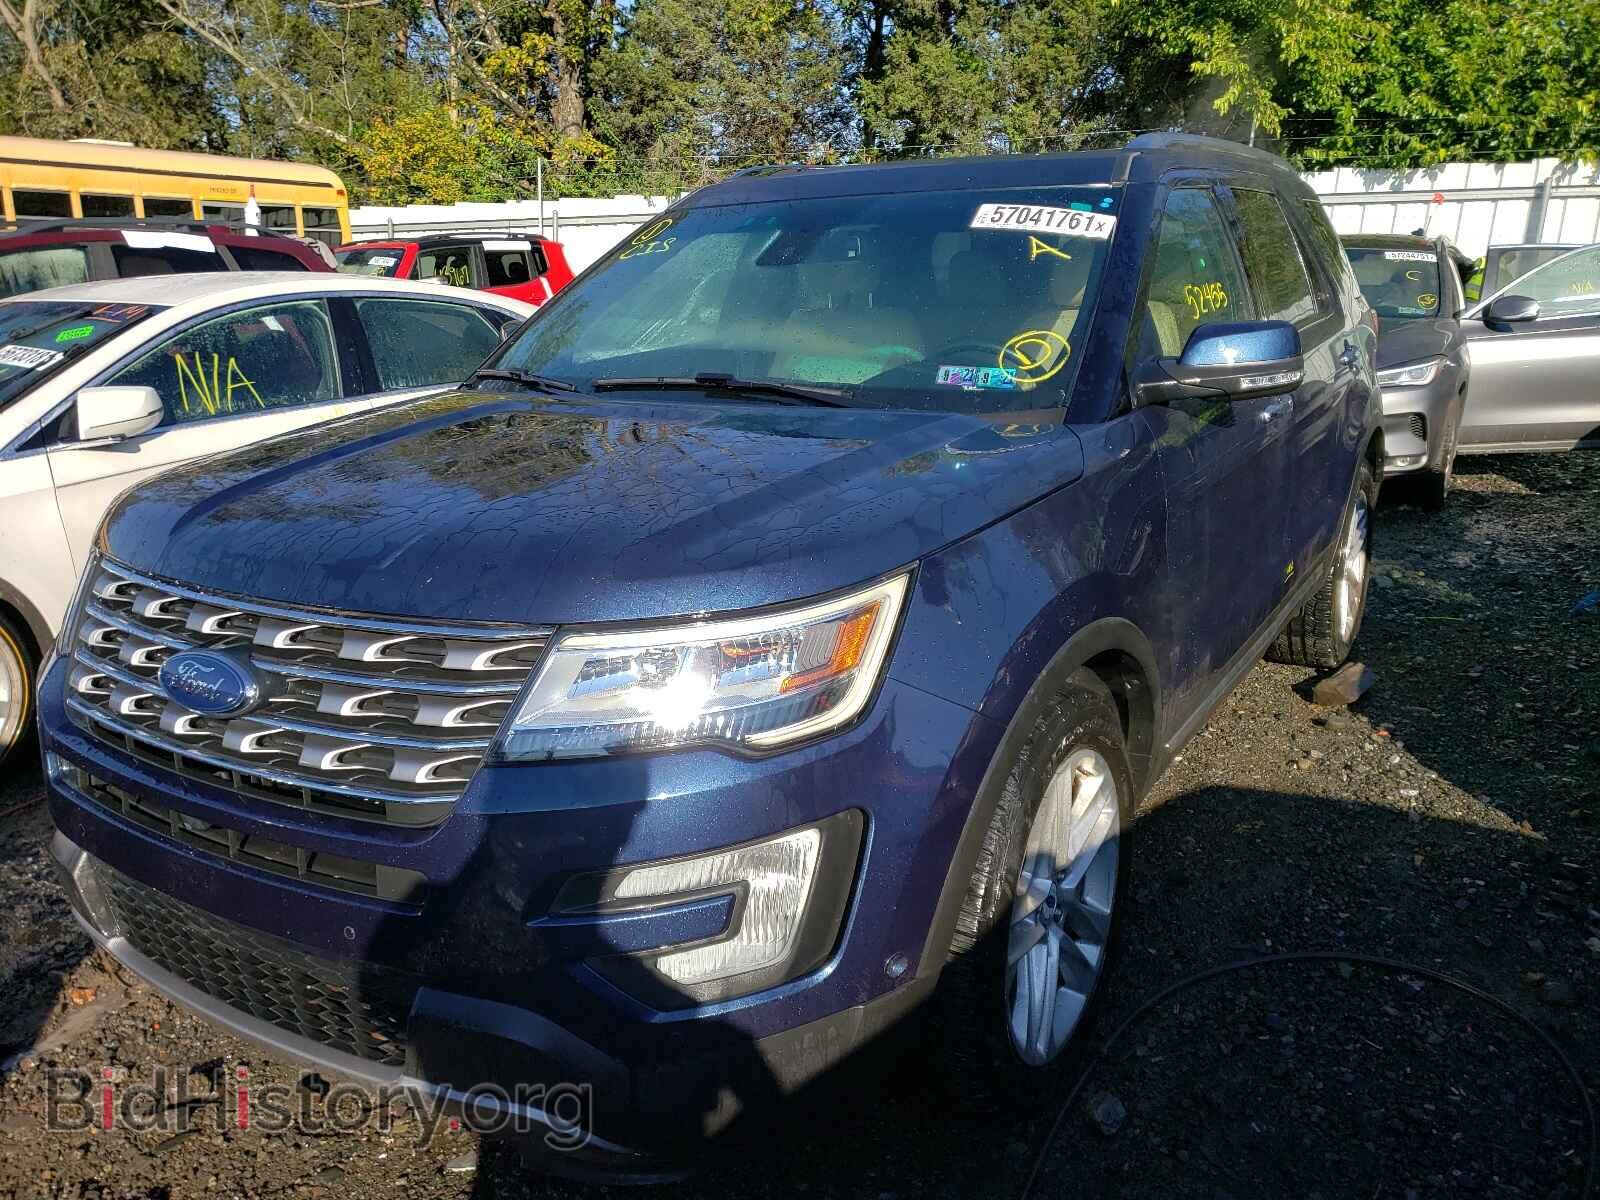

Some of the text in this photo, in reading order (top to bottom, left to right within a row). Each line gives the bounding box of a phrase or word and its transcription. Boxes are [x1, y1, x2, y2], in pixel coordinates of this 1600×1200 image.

[1028, 236, 1072, 260] A
[175, 351, 265, 415] N/A
[179, 660, 225, 692] Ford
